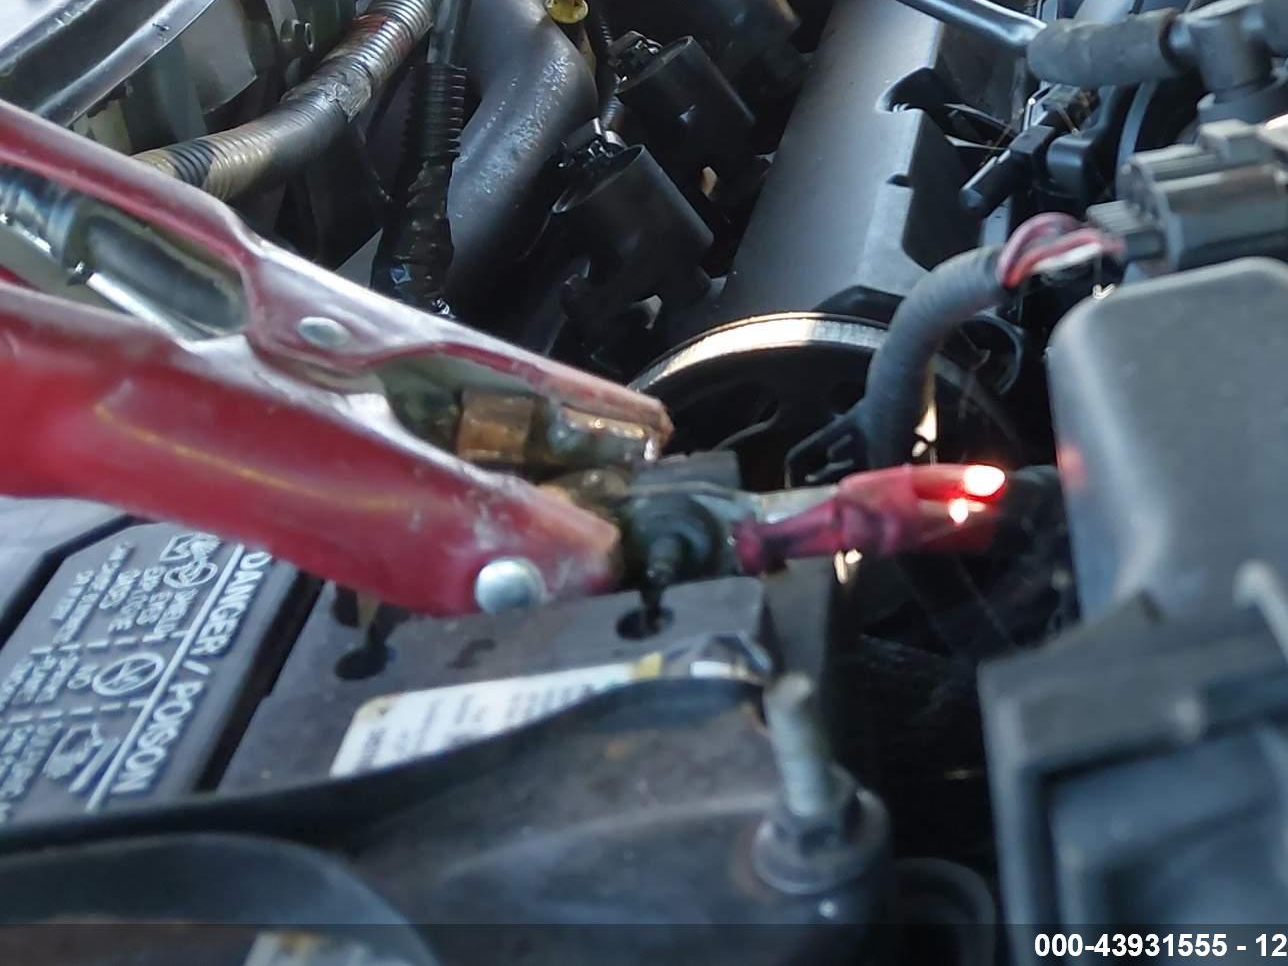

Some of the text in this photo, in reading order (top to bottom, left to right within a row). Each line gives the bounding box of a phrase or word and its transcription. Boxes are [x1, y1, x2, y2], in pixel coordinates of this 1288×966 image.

[109, 550, 273, 794] DANGER / POISON
